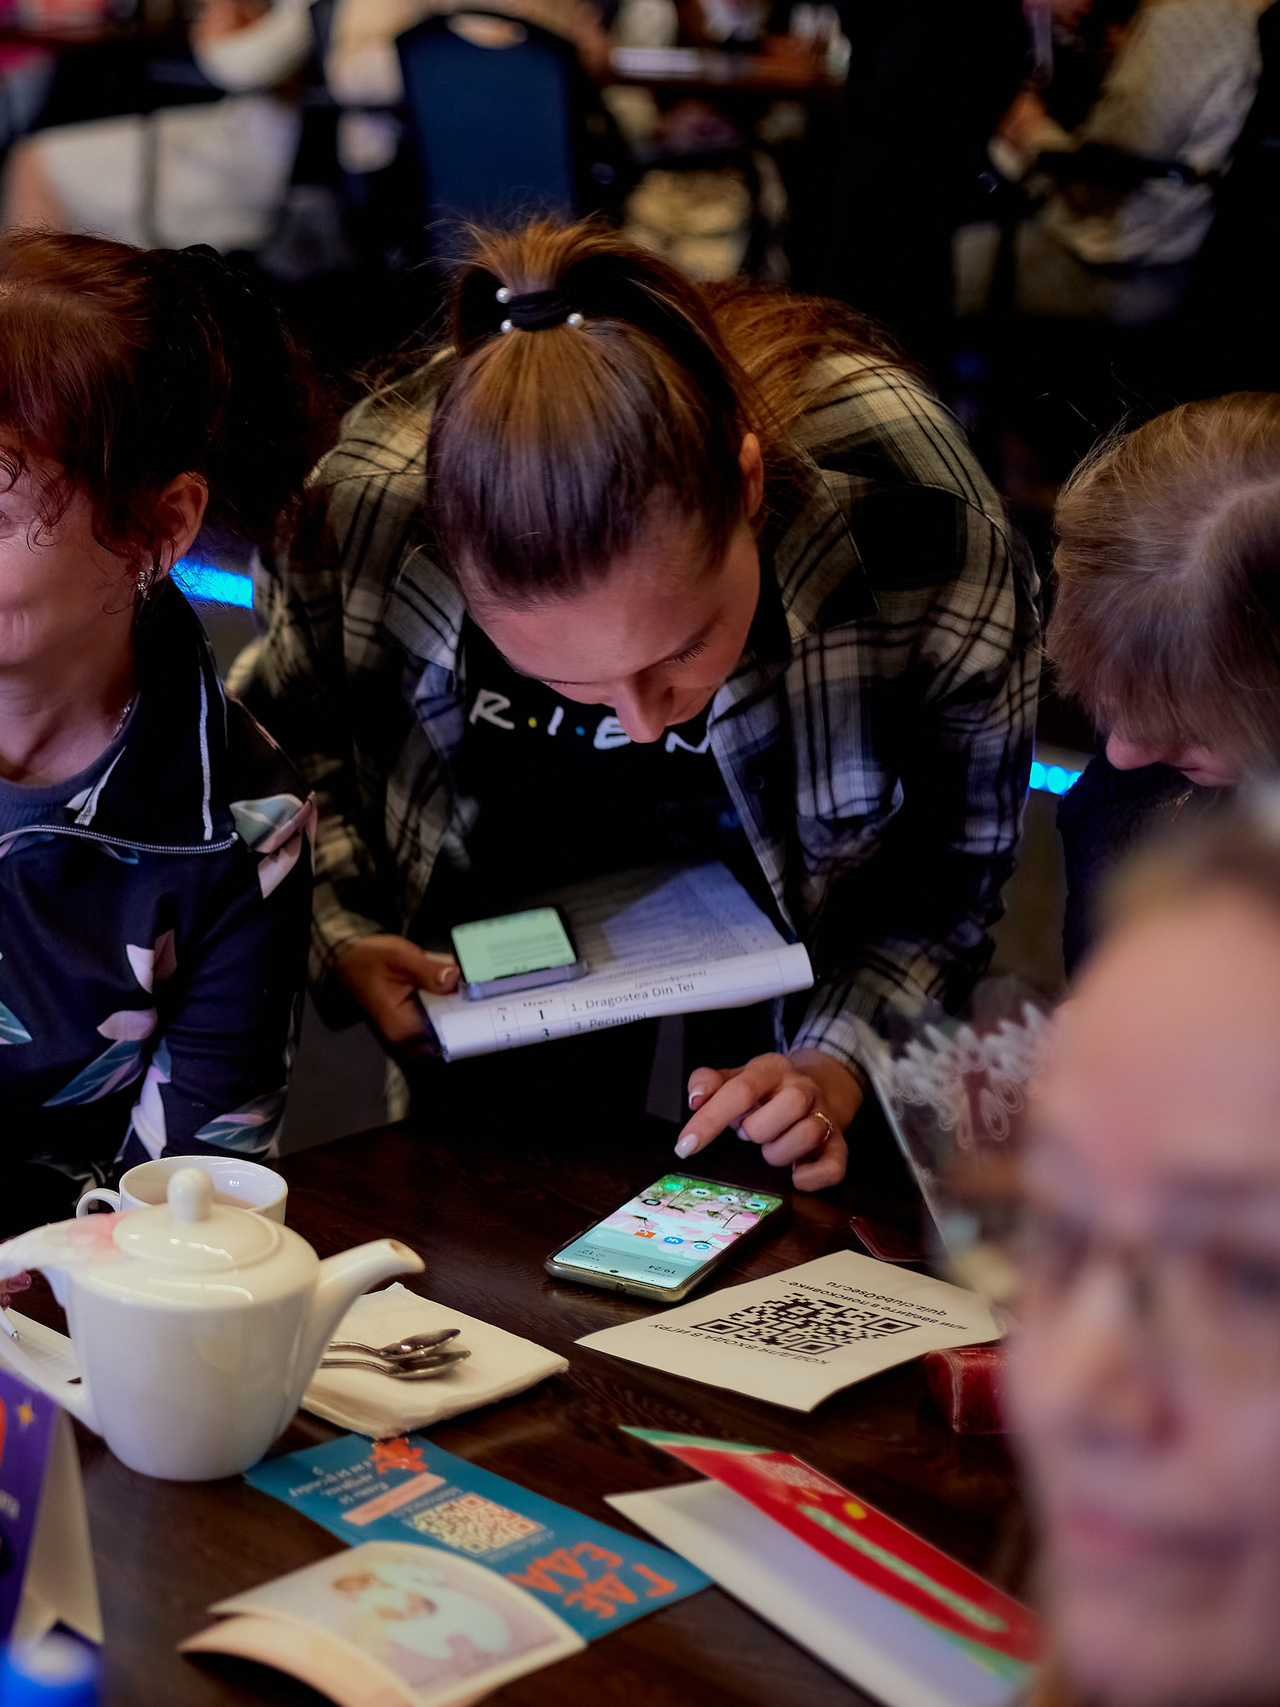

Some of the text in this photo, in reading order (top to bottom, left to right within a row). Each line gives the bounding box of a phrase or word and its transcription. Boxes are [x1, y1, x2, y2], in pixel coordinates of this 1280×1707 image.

[585, 990, 650, 1008] Dragostea
[651, 984, 675, 998] Din
[675, 981, 696, 993] Tei
[788, 1281, 871, 1307] поисковике
[880, 1306, 939, 1325] введите
[649, 1324, 691, 1335] ИГРУ
[938, 1321, 969, 1331] или
[704, 1335, 759, 1350] ВХОДА
[757, 1348, 796, 1358] ДЛЯ
[794, 1355, 831, 1365] КОД
